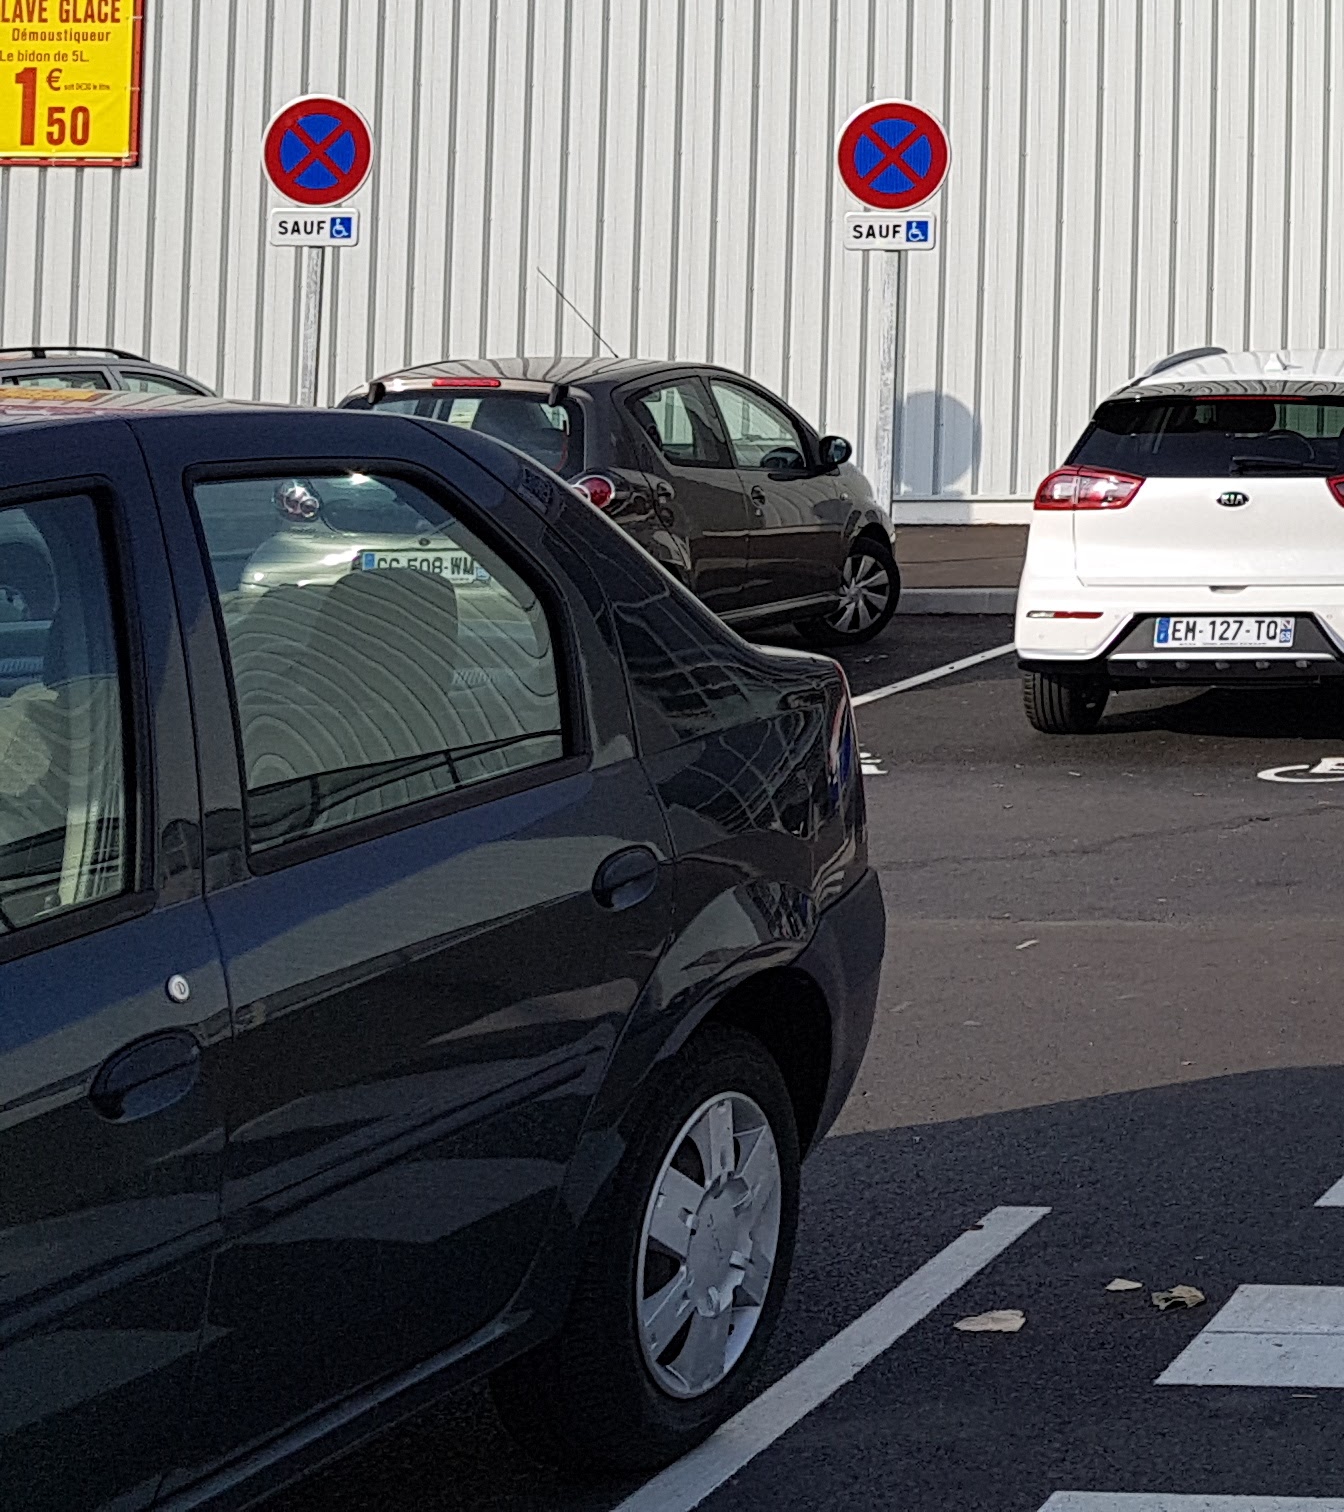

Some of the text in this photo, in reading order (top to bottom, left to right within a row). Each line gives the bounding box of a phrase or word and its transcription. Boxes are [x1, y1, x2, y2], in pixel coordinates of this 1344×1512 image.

[12, 28, 111, 44] Démoustiqueur
[0, 50, 14, 62] Le
[18, 50, 51, 62] bidon
[54, 50, 68, 62] de
[46, 105, 91, 147] 50
[278, 220, 327, 236] SAUF
[852, 224, 902, 240] SAUF
[1221, 493, 1244, 505] KIA
